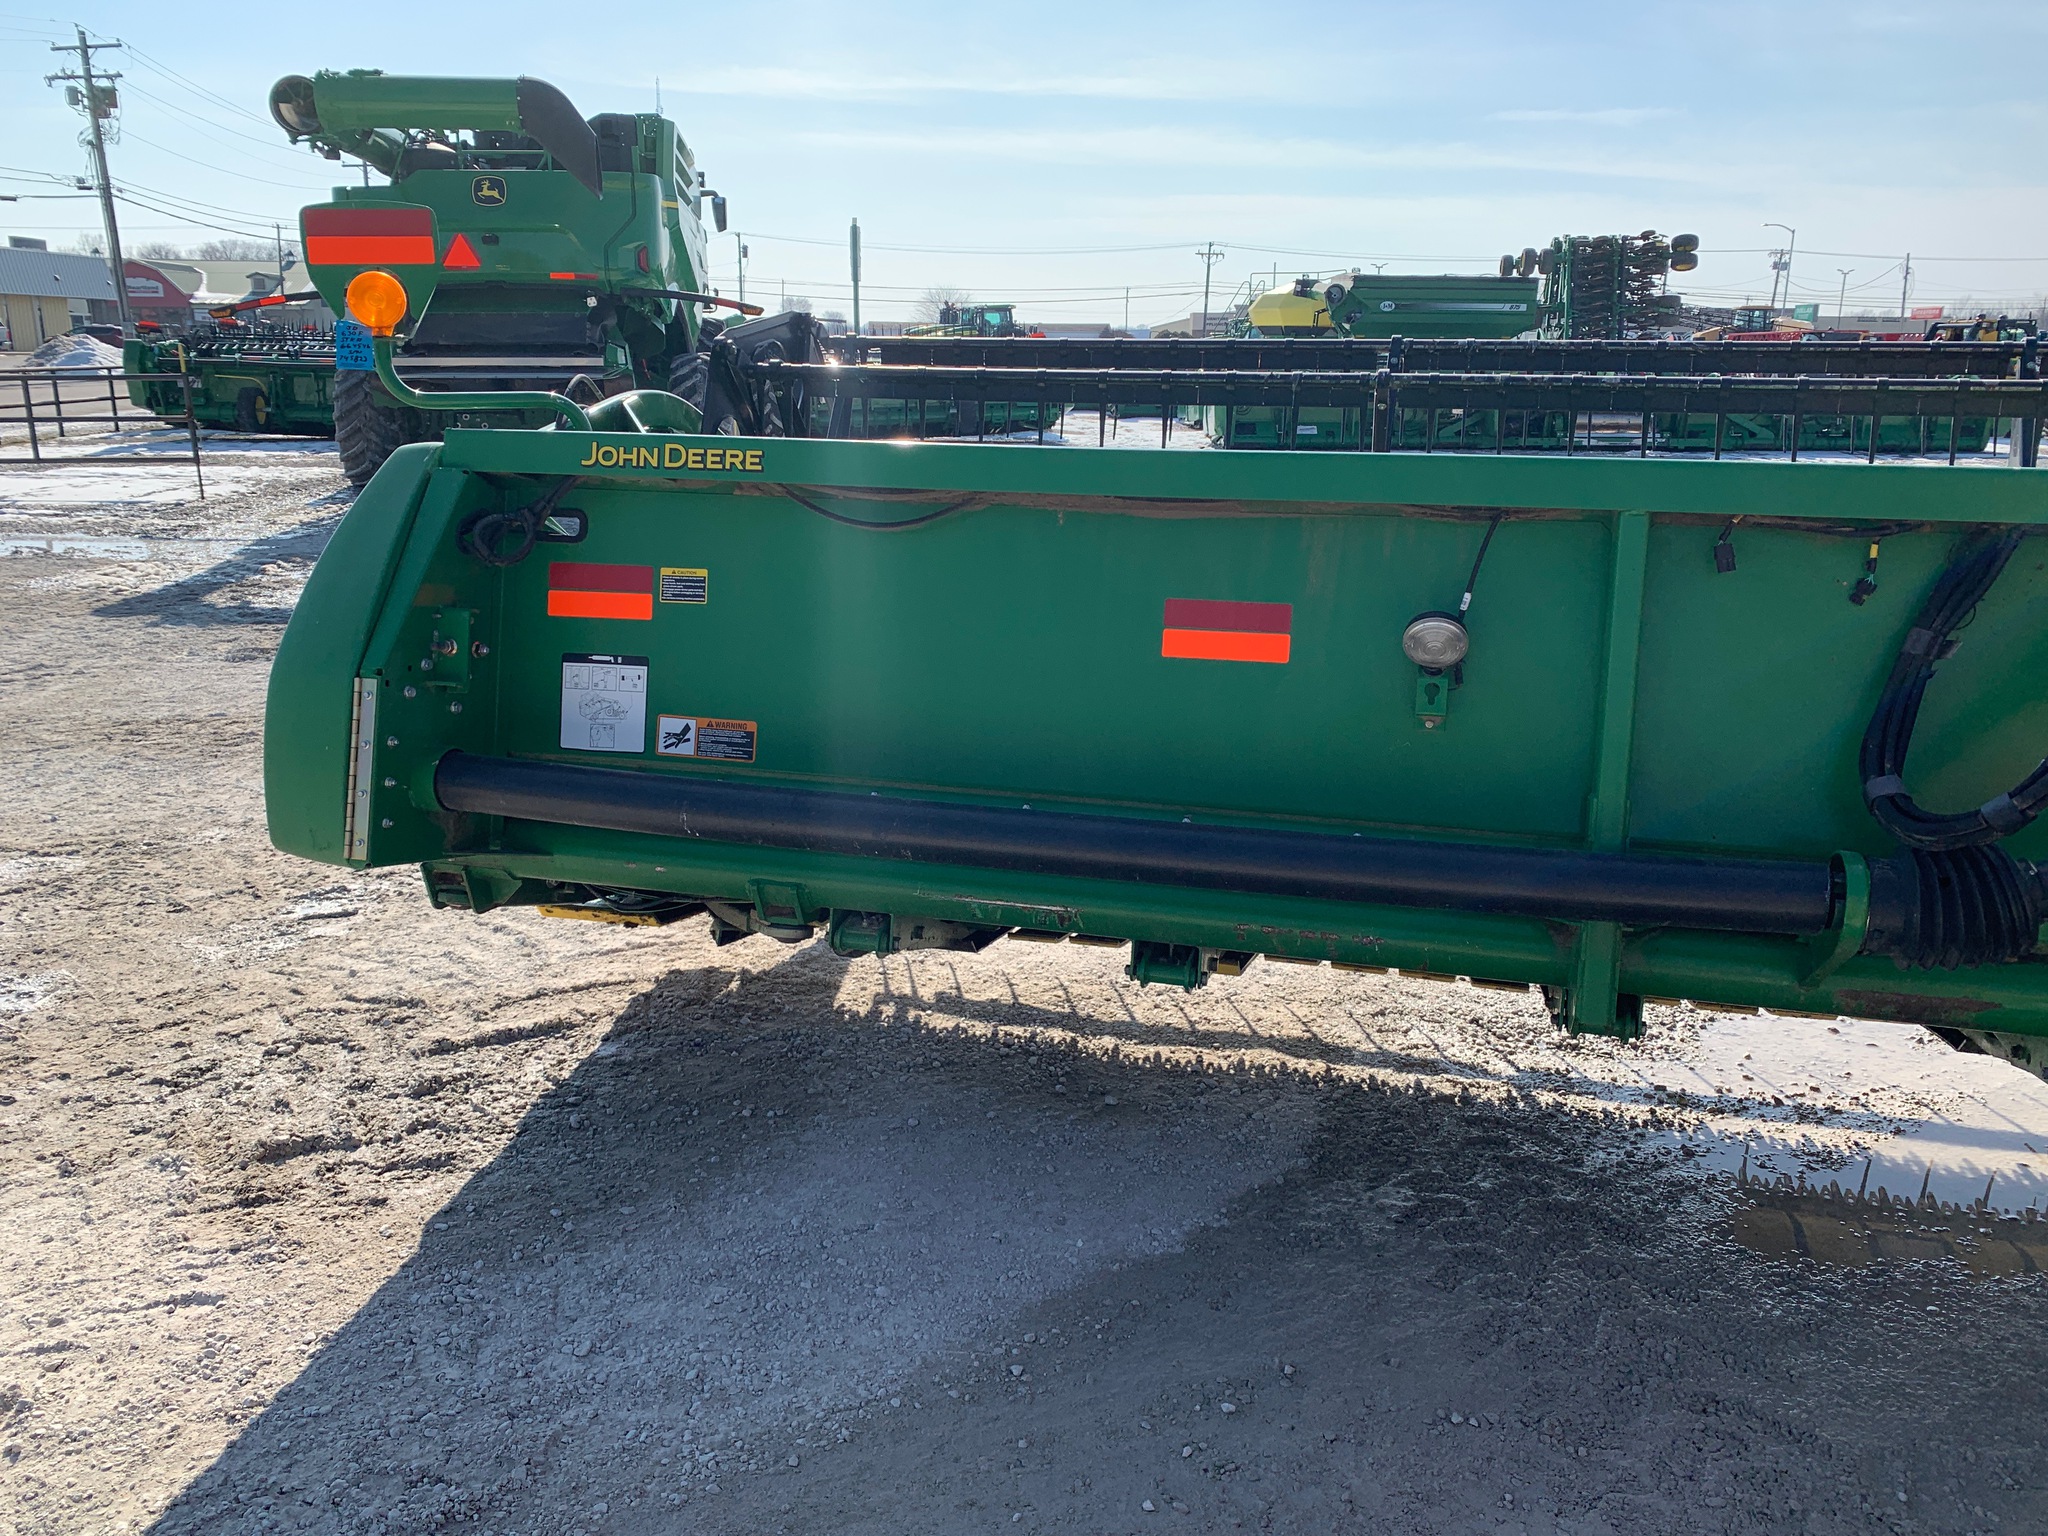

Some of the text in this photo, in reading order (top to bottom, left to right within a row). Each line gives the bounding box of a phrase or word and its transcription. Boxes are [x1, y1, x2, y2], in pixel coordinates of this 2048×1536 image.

[581, 441, 765, 472] JOHN DEERE
[715, 721, 748, 731] WARNING
